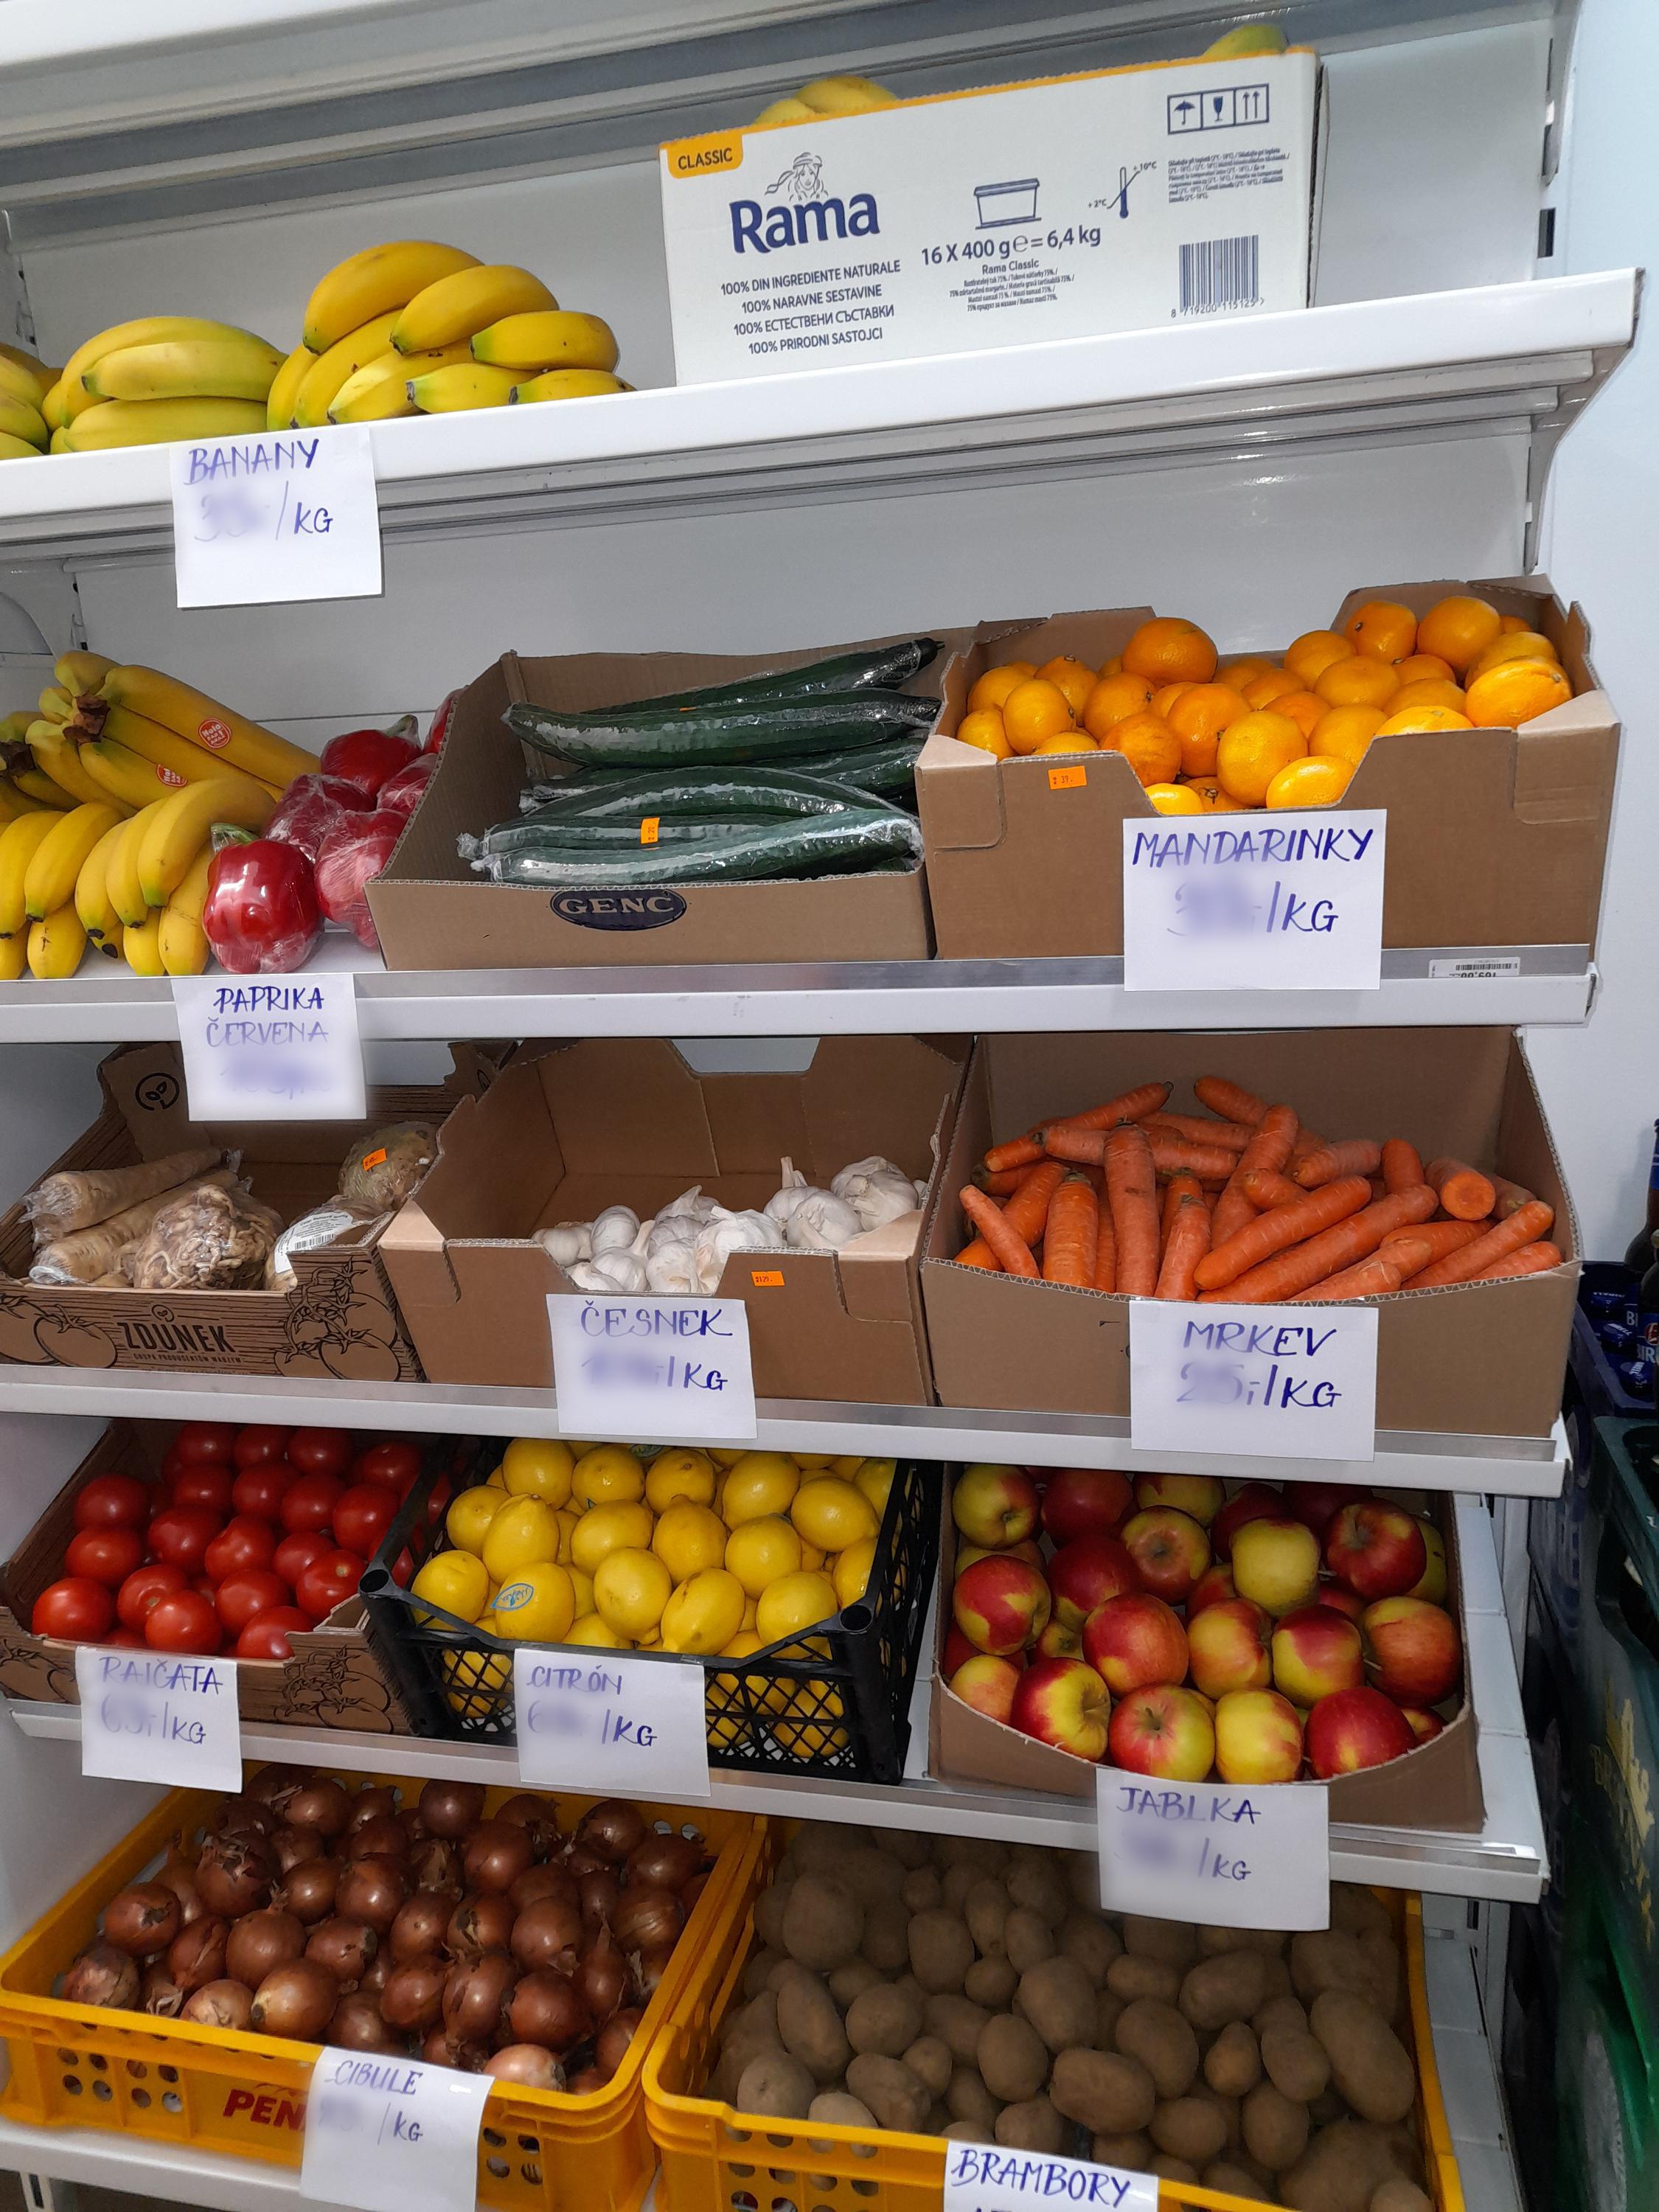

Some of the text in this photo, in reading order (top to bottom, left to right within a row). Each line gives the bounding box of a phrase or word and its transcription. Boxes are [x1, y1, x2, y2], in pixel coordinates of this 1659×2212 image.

[677, 147, 734, 170] CLASSIC
[729, 192, 880, 254] Rama
[922, 246, 942, 265] 16
[961, 239, 995, 260] 400
[1079, 224, 1101, 247] kg
[721, 260, 901, 296] 100% DIN INGREDIENTE NATURALE
[982, 258, 1040, 275] Rama Classic
[742, 284, 883, 314] 100% NARAVNE SESTAVINE
[733, 320, 763, 336] 100%
[748, 328, 883, 355] 100% PRIRODNI SASTOJCI
[183, 438, 319, 486] BANANY
[1132, 828, 1374, 869] MANDARINKY
[559, 897, 675, 914] GENC
[212, 985, 324, 1015] PAPRIKA
[206, 1016, 330, 1048] ČERVENA
[580, 1300, 733, 1337] ČESNEK
[116, 1322, 236, 1352] ZDUNEK
[1183, 1320, 1338, 1357] MRKEV
[526, 1664, 622, 1695] CITRÓN
[1116, 1787, 1262, 1824] JABLKA
[324, 2060, 423, 2096] CIBULE
[951, 2149, 1131, 2208] BRAMBORY
